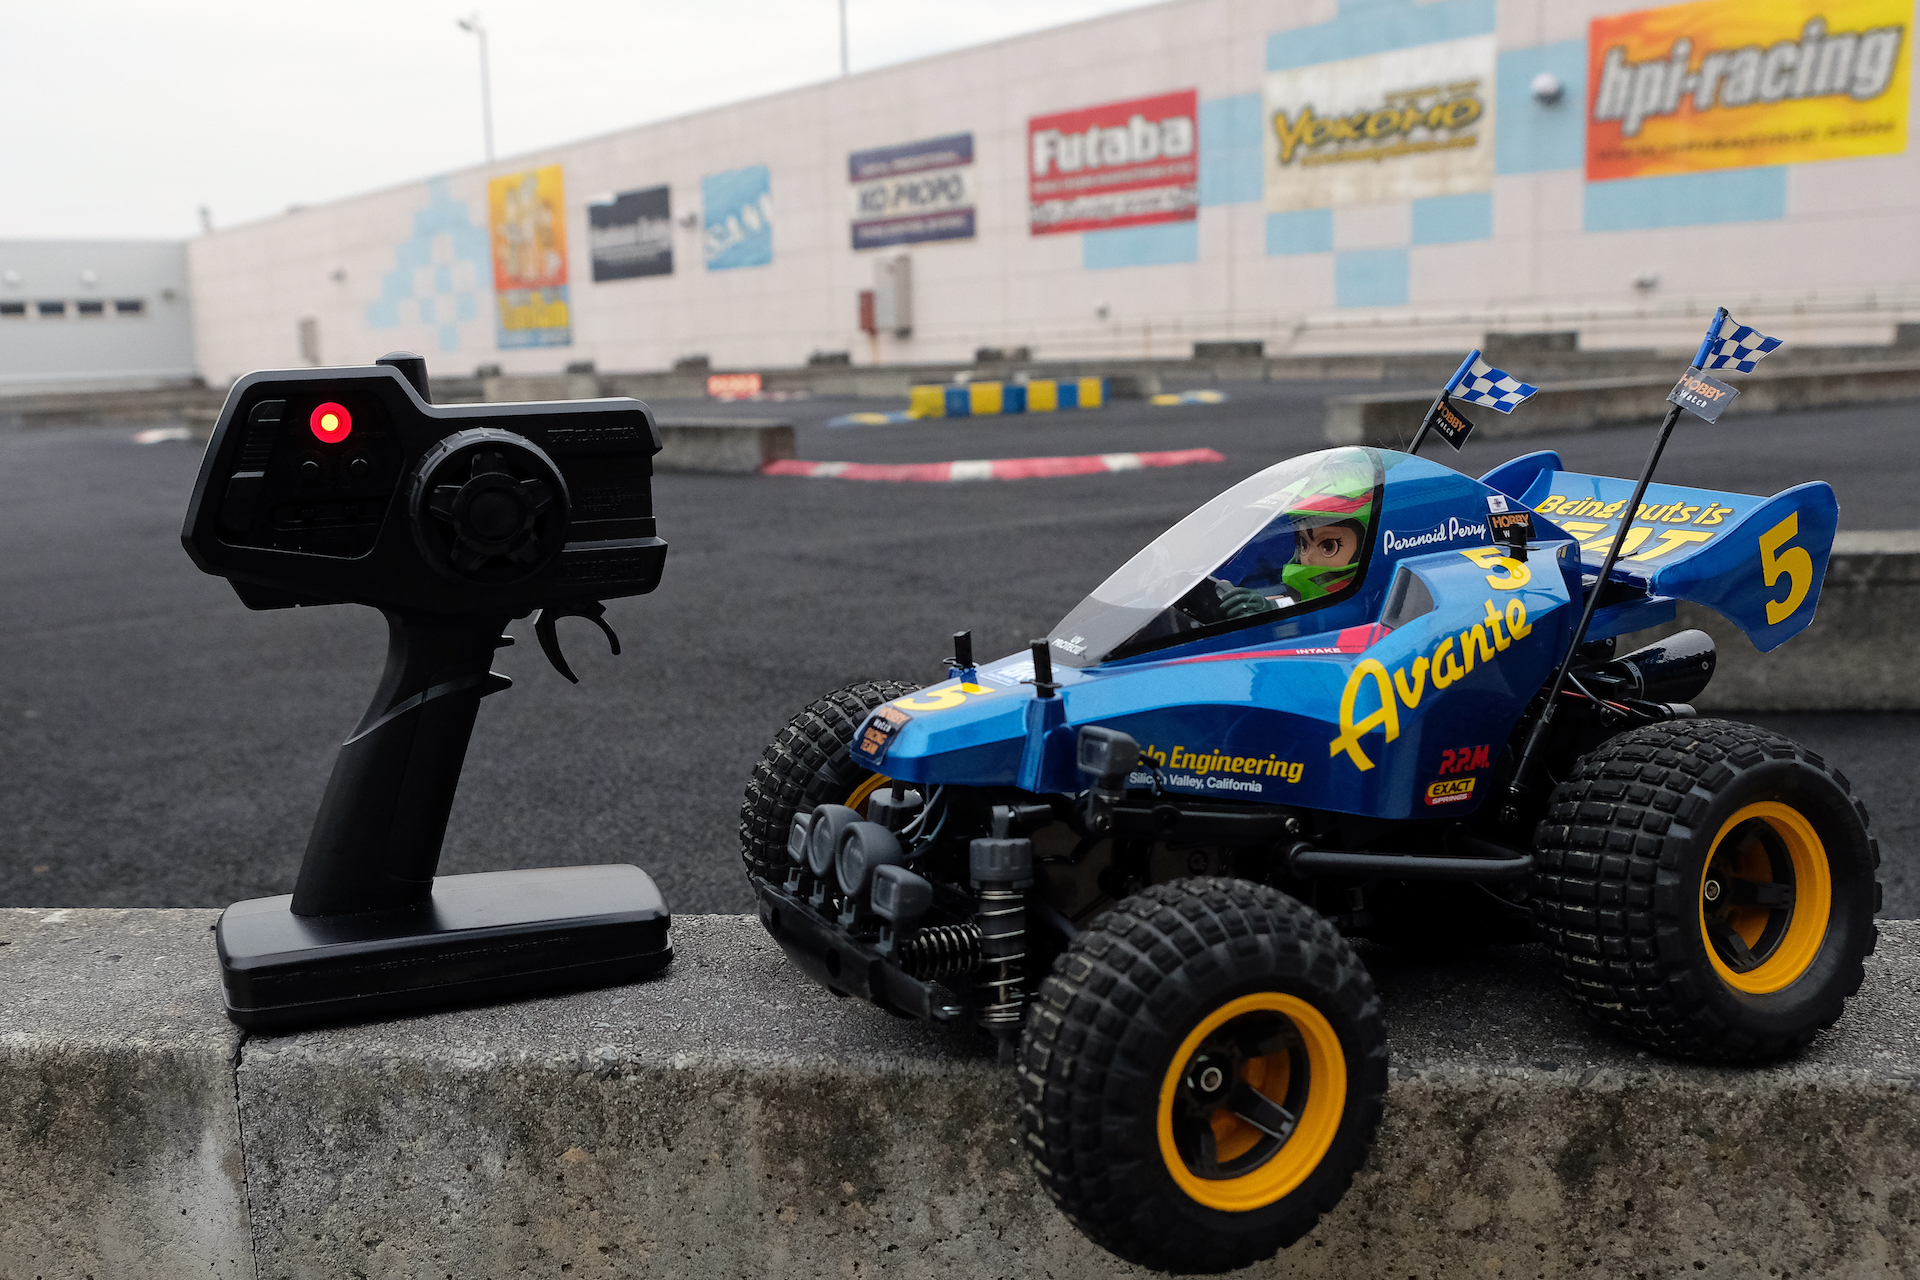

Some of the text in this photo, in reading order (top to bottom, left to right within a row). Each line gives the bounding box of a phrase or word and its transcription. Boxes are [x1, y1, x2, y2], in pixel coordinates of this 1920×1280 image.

[1033, 113, 1193, 177] Futaba
[1679, 373, 1726, 402] HOBBY
[1679, 389, 1708, 409] Watch
[1533, 494, 1628, 519] Being
[1692, 502, 1734, 526] is
[1383, 516, 1487, 555] Paranoid Perry
[1459, 547, 1531, 590] 5
[1758, 511, 1813, 626] 5
[893, 682, 996, 711] 5
[1329, 597, 1532, 772] Avante
[1169, 745, 1305, 783] Engineering
[1169, 773, 1205, 790] Valley,
[1206, 776, 1263, 793] California
[1431, 793, 1468, 805] SPRINGS
[1433, 779, 1472, 796] EXACT
